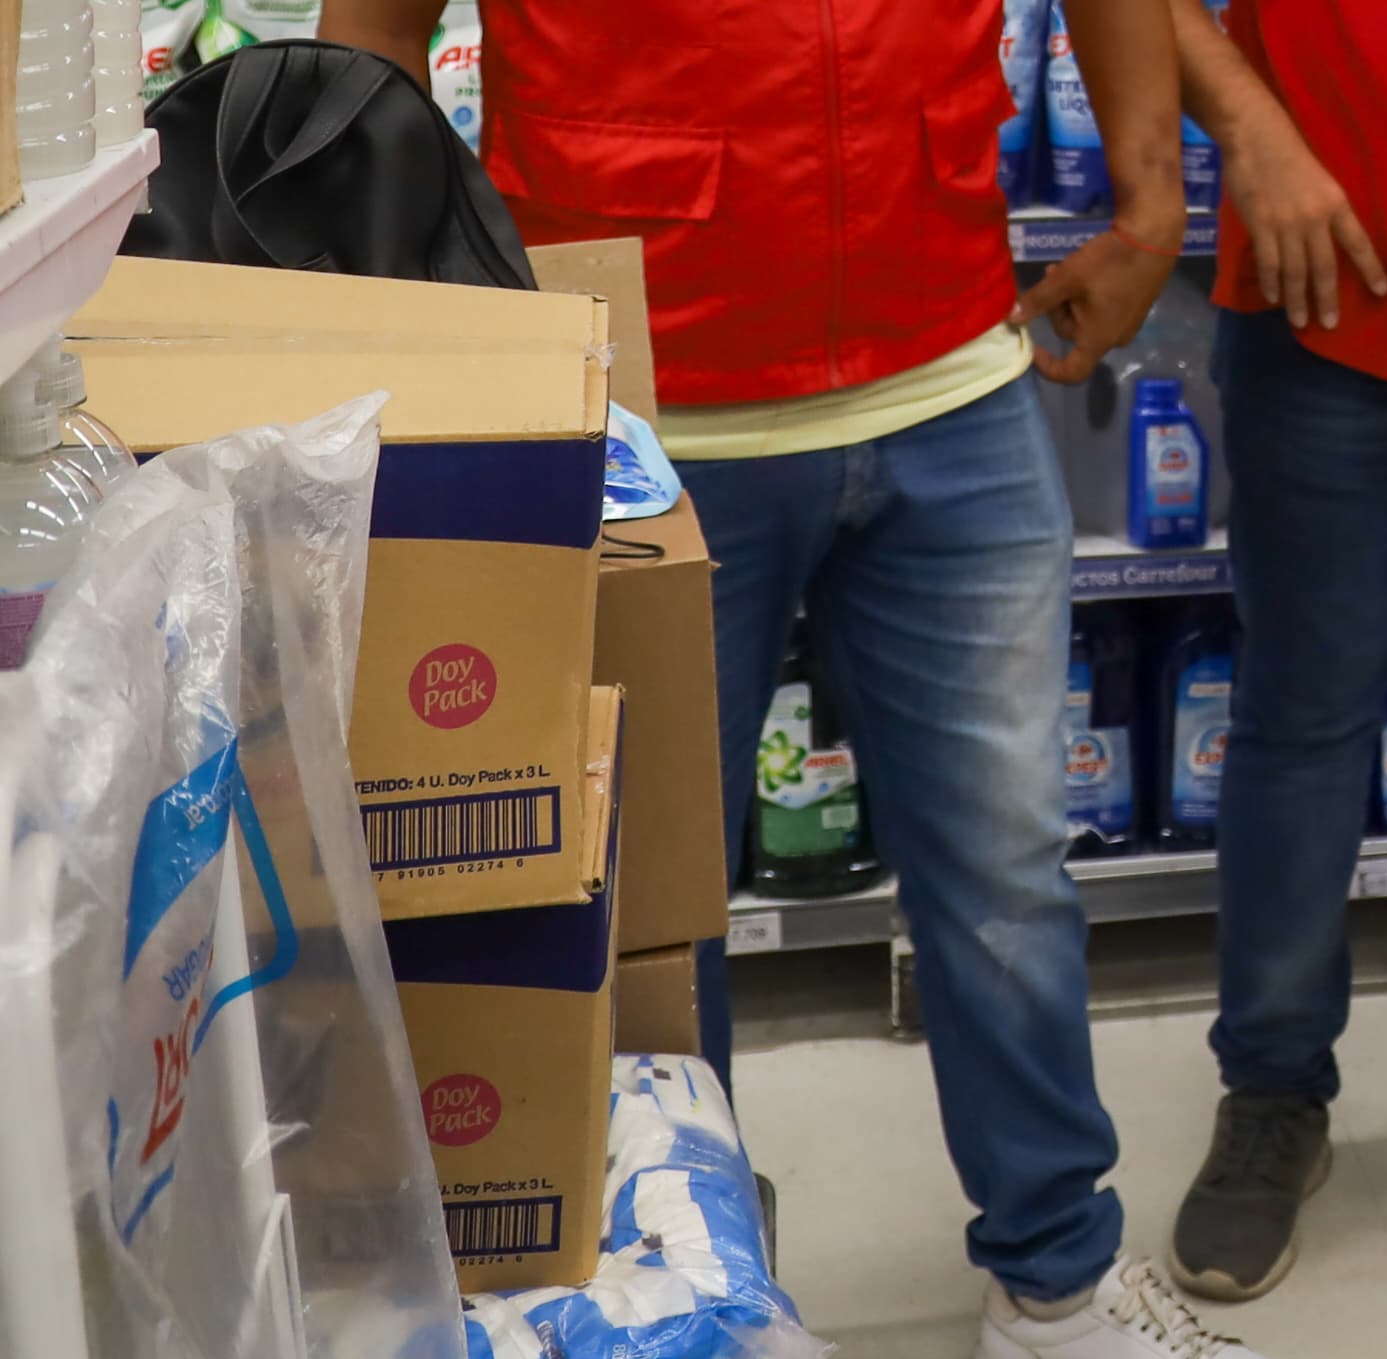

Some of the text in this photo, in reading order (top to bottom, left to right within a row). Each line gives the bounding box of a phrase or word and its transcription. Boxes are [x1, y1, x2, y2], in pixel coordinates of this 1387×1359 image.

[1123, 565, 1218, 587] Carrefour
[425, 655, 475, 688] Doy
[424, 679, 487, 717] Pack
[355, 778, 413, 795] TENIDO:
[416, 777, 427, 789] 4
[430, 775, 445, 788] U.
[449, 772, 476, 787] Doy
[478, 767, 512, 784] Pack
[514, 769, 524, 779] x
[526, 766, 535, 778] 3
[397, 866, 446, 881] 91905
[456, 859, 504, 875] 02274
[516, 858, 524, 869] 6
[433, 1084, 481, 1113] Doy
[430, 1103, 492, 1137] Pack
[453, 1182, 482, 1197] Doy
[482, 1179, 517, 1194] Pack
[518, 1181, 527, 1191] x
[529, 1178, 539, 1190] 3
[459, 1255, 523, 1267] 02274 6
